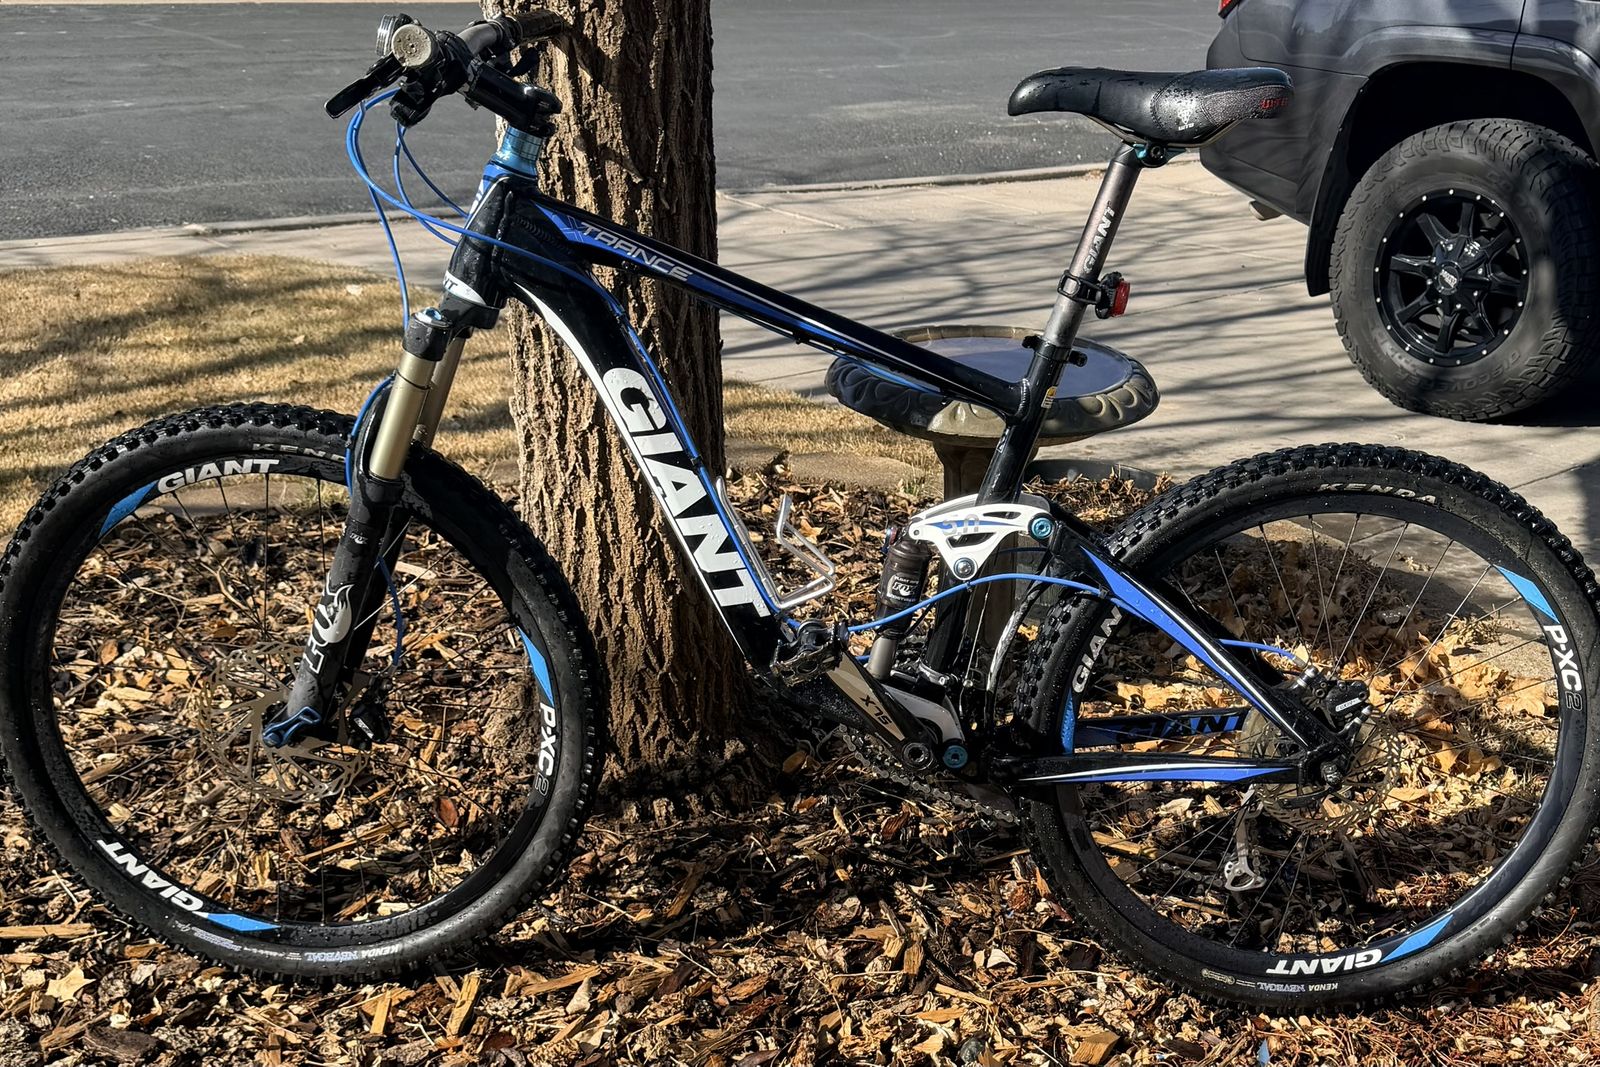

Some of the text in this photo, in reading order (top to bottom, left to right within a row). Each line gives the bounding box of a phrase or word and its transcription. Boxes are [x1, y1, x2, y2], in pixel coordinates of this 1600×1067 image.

[581, 221, 693, 282] TRANCE
[1083, 206, 1115, 274] GIANT
[252, 443, 346, 463] KEND
[157, 458, 280, 494] GIANT
[603, 367, 771, 618] GIANT
[1317, 483, 1437, 504] KENDA
[1072, 605, 1122, 693] GIAN
[860, 695, 892, 725] SLX
[97, 840, 204, 911] GIANT
[361, 943, 400, 959] KENDA
[1266, 949, 1382, 975] GIANT
[1257, 982, 1339, 992] KENDA NEVEGAL
